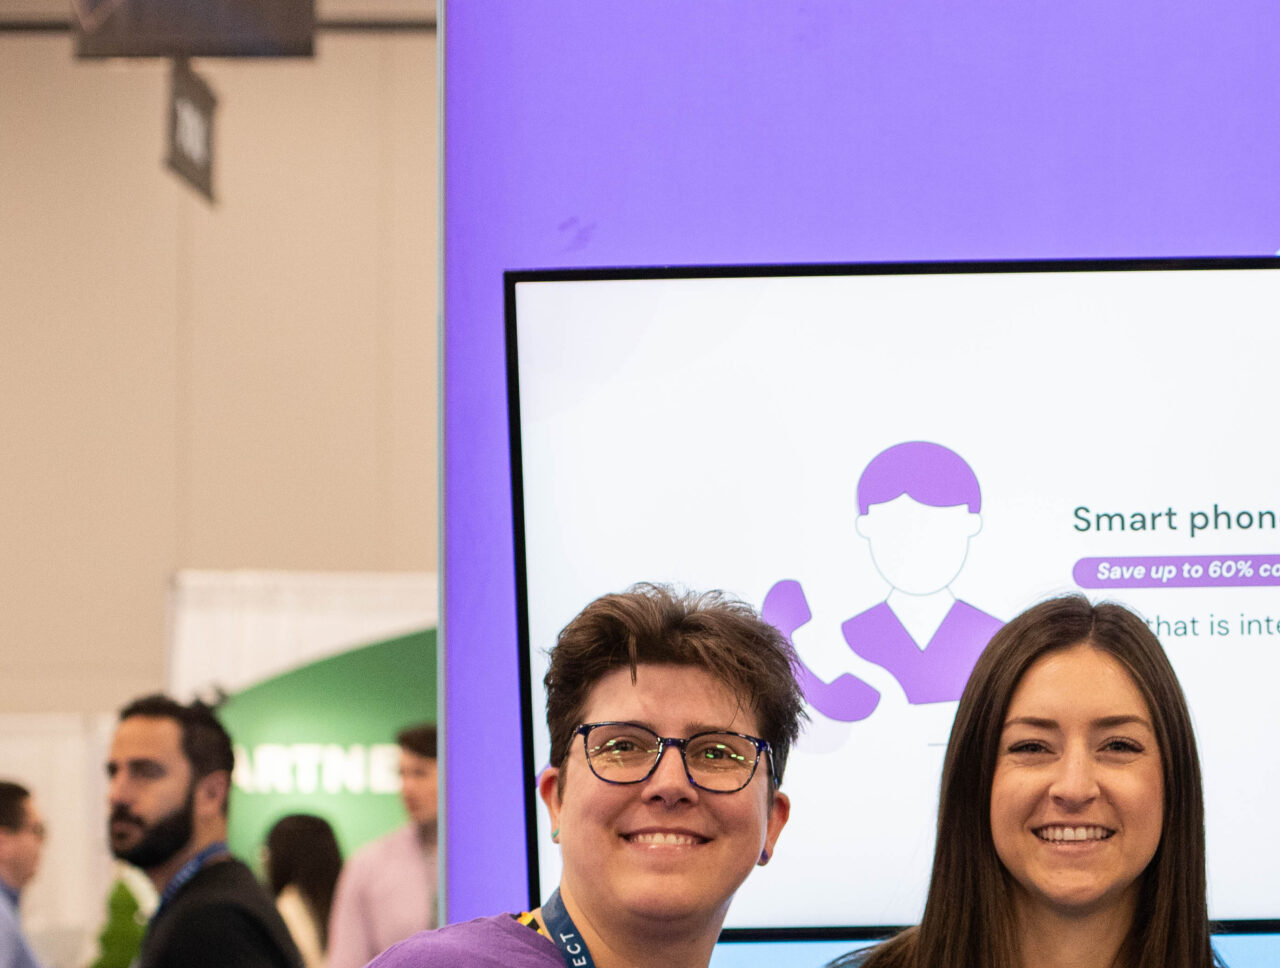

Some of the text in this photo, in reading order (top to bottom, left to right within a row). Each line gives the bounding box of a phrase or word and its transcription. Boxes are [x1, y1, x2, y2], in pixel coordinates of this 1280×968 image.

[1073, 506, 1177, 532] Smart
[1097, 561, 1145, 580] Save
[1151, 563, 1177, 581] up
[1182, 562, 1202, 579] to
[1208, 560, 1254, 578] 60%
[1147, 613, 1199, 638] that
[1210, 613, 1230, 637] is
